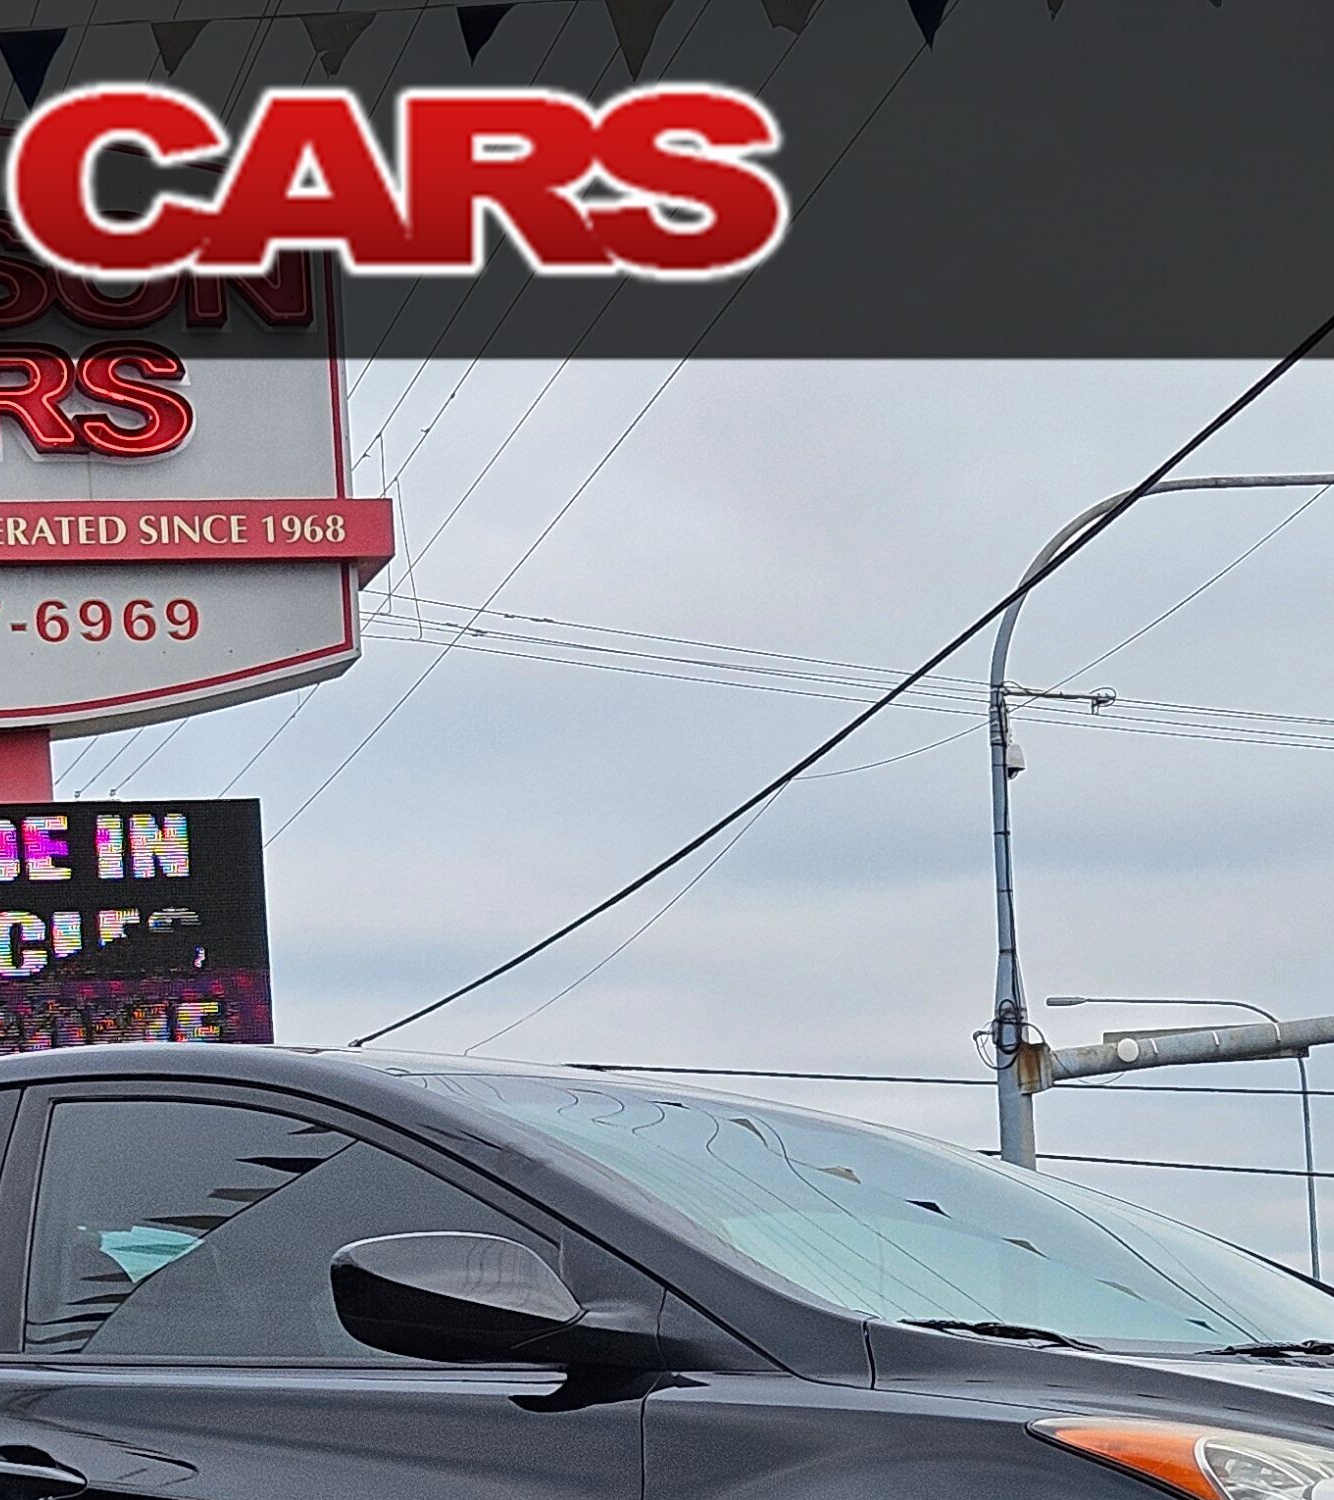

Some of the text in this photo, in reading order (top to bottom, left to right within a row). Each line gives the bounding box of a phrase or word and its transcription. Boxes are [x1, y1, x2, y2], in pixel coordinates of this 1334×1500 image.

[139, 513, 247, 545] SINCE
[262, 514, 346, 543] 1968
[96, 814, 190, 878] IN
